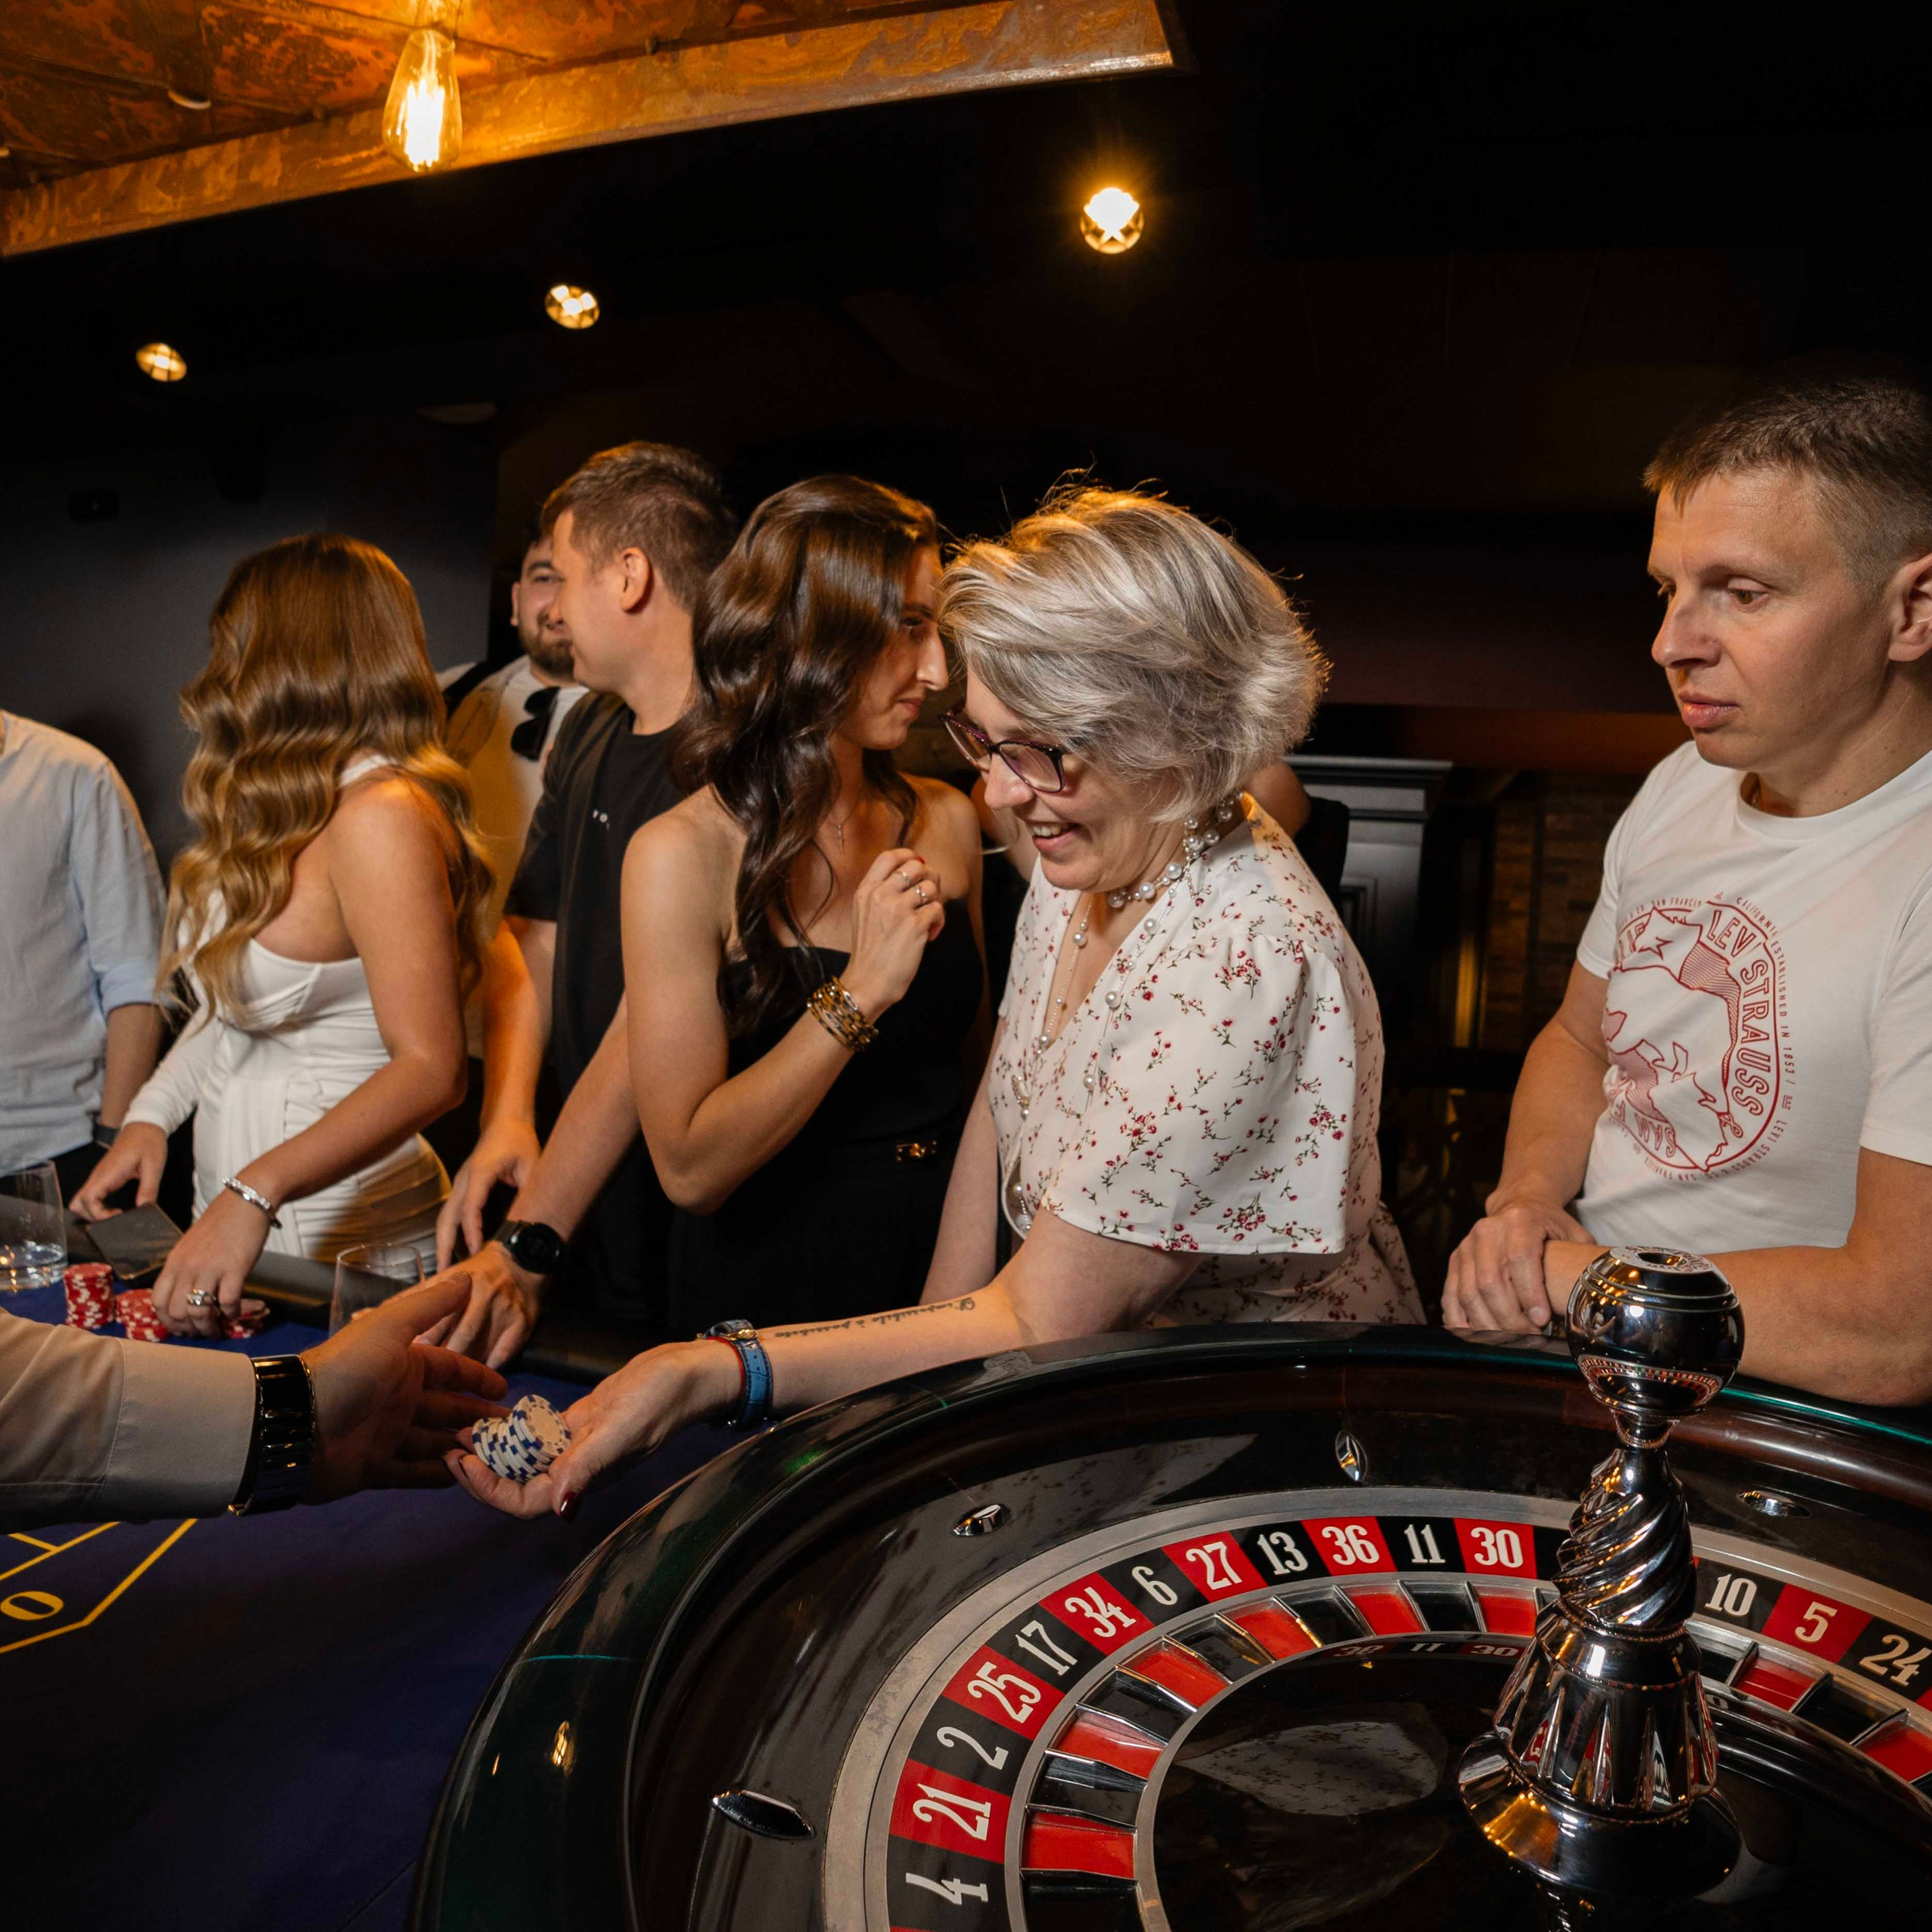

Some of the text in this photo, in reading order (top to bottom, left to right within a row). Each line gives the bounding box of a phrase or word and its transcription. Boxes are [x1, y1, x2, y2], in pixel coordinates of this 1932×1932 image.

[1706, 910, 1761, 958] LEV
[1771, 941, 1788, 1017] ESTABLISHED
[1731, 959, 1770, 1115] STRAUSS
[1781, 1026, 1790, 1038] IN
[1783, 1047, 1795, 1074] 1853
[1767, 1120, 1787, 1143] LEVI
[1731, 1144, 1770, 1171] STRAUSS
[1257, 1531, 1309, 1576] 13
[1321, 1524, 1380, 1564] 36
[1404, 1524, 1446, 1564] 11
[1470, 1527, 1524, 1567] 30
[1132, 1565, 1178, 1605] 6
[1186, 1541, 1244, 1591] 27
[0, 1591, 64, 1620] 0
[1065, 1586, 1137, 1638] 34
[1704, 1574, 1758, 1617] 10
[1795, 1601, 1838, 1643] 5
[1015, 1620, 1078, 1676] 17
[1858, 1634, 1932, 1687] 24
[967, 1662, 1041, 1724] 25
[937, 1726, 1009, 1770] 2
[912, 1783, 991, 1841] 21
[906, 1872, 988, 1905] 4
